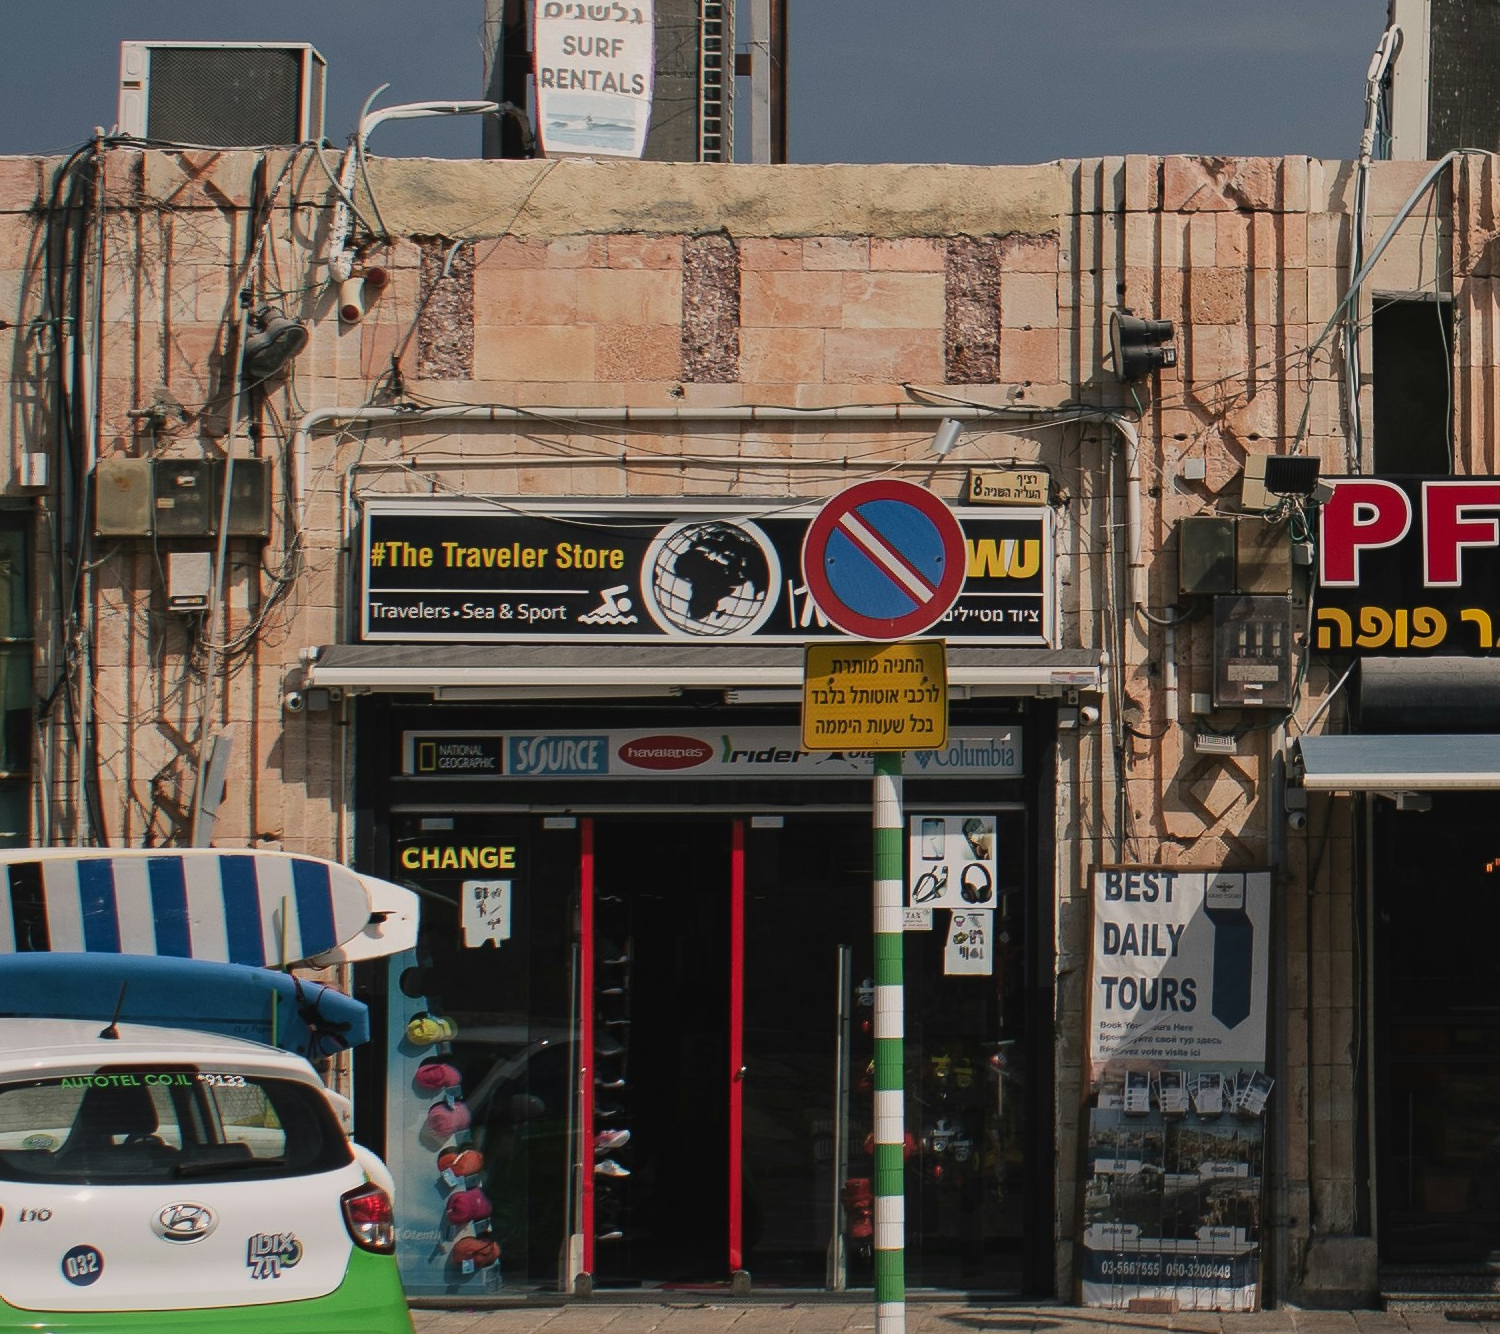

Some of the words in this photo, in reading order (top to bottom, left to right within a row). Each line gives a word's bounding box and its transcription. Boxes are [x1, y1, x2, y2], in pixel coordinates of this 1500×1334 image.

[544, 1, 644, 25] גלשנים
[563, 34, 625, 58] SURF
[541, 67, 645, 95] RENTALS
[973, 476, 983, 496] 8
[1016, 474, 1038, 488] רציף
[984, 487, 1011, 498] השניה
[1013, 488, 1041, 499] העליה
[371, 541, 434, 568] #The
[442, 542, 548, 568] Traveler
[556, 542, 624, 569] Store
[462, 603, 495, 620] Sea
[499, 604, 514, 620] &
[518, 604, 567, 624] Sport
[1007, 609, 1040, 623] ציוד
[1317, 606, 1448, 649] פופה
[831, 658, 879, 674] מותרת
[883, 658, 924, 673] החניה
[811, 685, 846, 704] בלבד
[850, 685, 900, 704] אוטותל
[904, 684, 940, 703] לרכבי
[815, 718, 862, 734] היממה
[866, 718, 905, 735] שעות
[909, 714, 934, 733] בכל
[439, 744, 483, 756] NATIONAL
[516, 736, 599, 775] SOURCE
[627, 747, 705, 759] havaianas
[729, 746, 809, 763] rider
[933, 740, 1015, 769] Columbia
[439, 757, 496, 769] GEOGRAPHIC
[402, 846, 516, 869] CHANGE
[1104, 871, 1179, 903] BEST
[1102, 922, 1186, 957] DAILY
[1100, 976, 1198, 1013] TOURS
[1099, 1021, 1122, 1029] Book
[1173, 1023, 1194, 1032] Here
[1155, 1035, 1177, 1044] свой
[1179, 1037, 1194, 1046] тур
[1141, 1048, 1163, 1056] votre
[1165, 1048, 1188, 1056] visite
[1190, 1048, 1201, 1057] ici
[61, 1074, 141, 1089] AUTOTEL
[145, 1073, 193, 1086] CO.IL
[67, 1252, 99, 1278] 032
